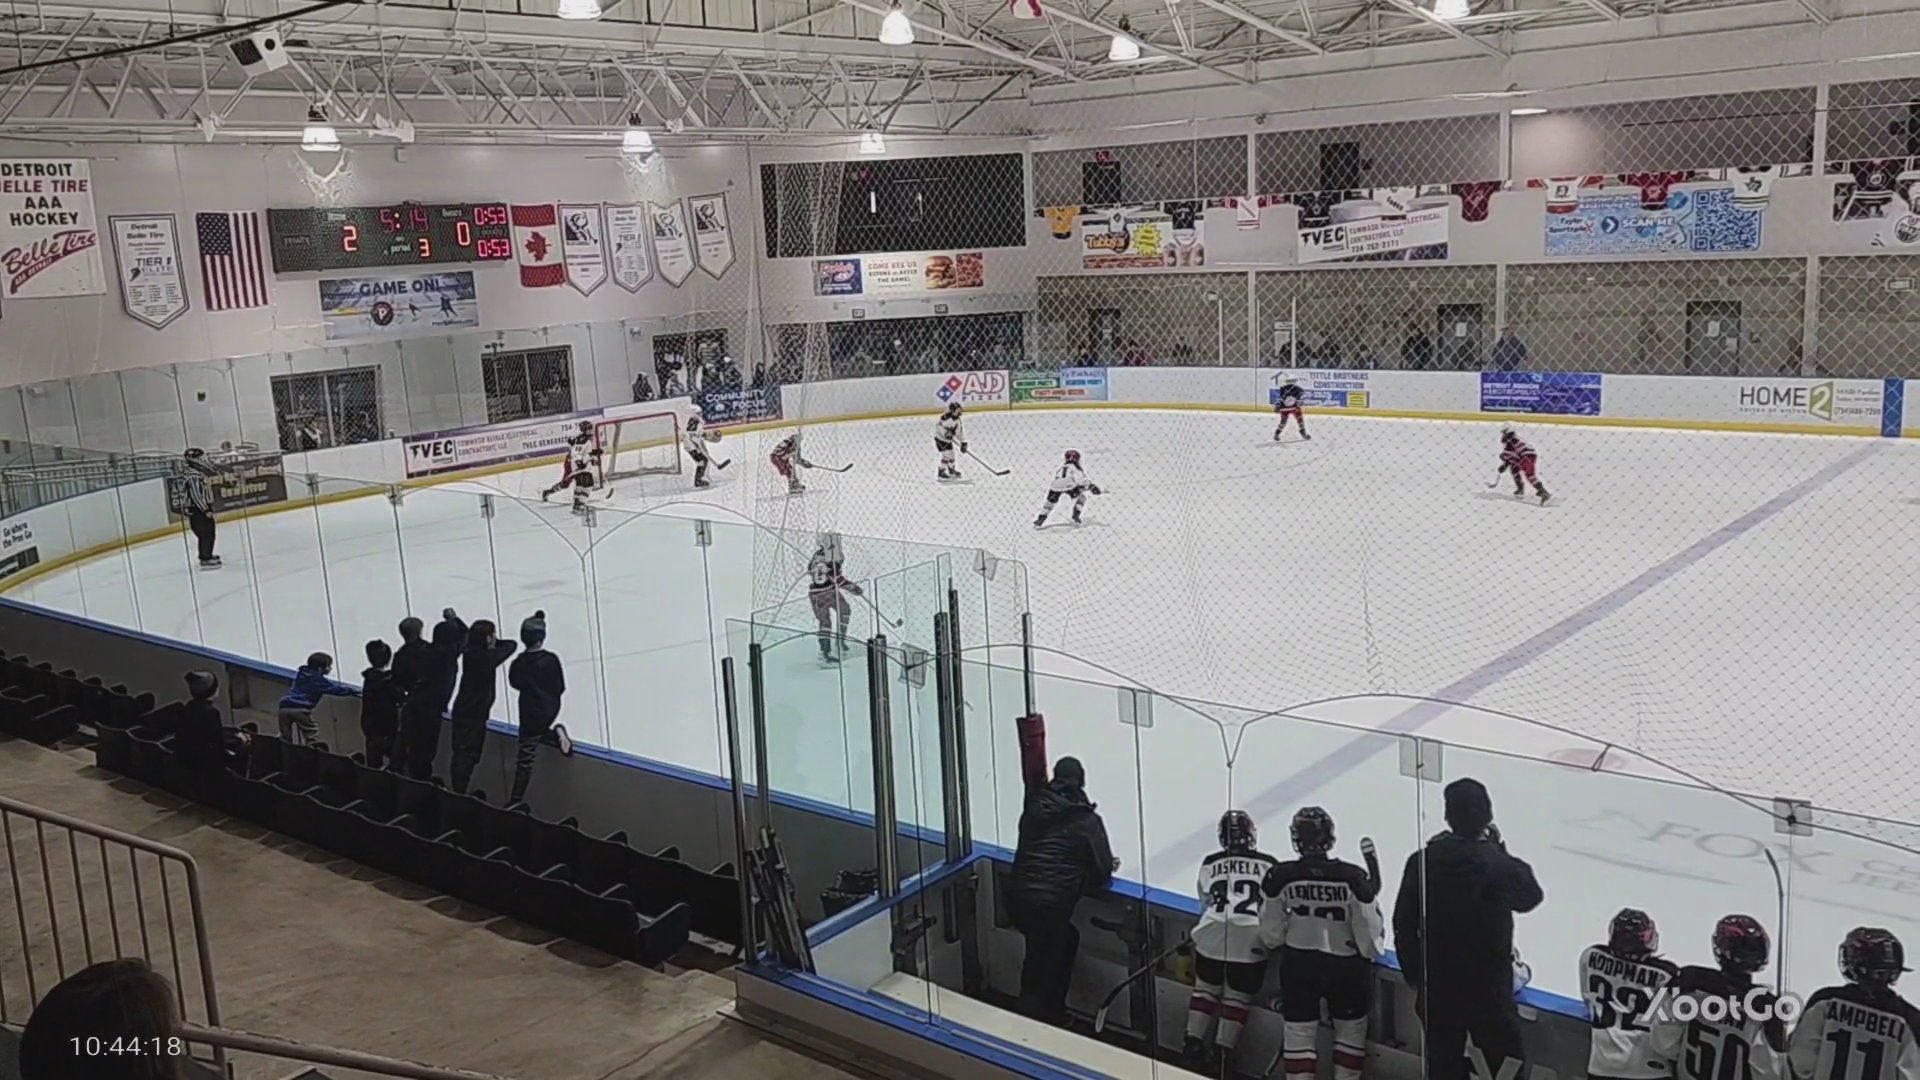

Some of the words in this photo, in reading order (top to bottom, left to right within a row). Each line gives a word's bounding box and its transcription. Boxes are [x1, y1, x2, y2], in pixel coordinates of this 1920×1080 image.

[1, 163, 72, 176] DETROIT
[0, 179, 43, 193] ELLE
[51, 179, 88, 192] TIRE
[25, 196, 62, 209] AAA
[9, 212, 79, 226] HOCKEY
[474, 207, 507, 225] 0:53
[1622, 217, 1655, 228] SCAN
[1658, 215, 1675, 226] ME
[343, 225, 358, 251] 2
[457, 221, 470, 246] 0
[1300, 225, 1345, 247] TVEC
[1, 238, 60, 275] Belle
[53, 229, 97, 257] Tire
[419, 238, 430, 257] 3
[477, 239, 510, 257] 0:53
[135, 256, 163, 267] TIER
[360, 280, 408, 297] GAME
[705, 389, 766, 402] COMMUNITY
[732, 399, 767, 410] FOCUS
[1739, 386, 1808, 407] HOME
[1812, 385, 1831, 418] 2
[409, 439, 453, 459] TVEC
[1640, 820, 1834, 876] FOX
[1210, 859, 1261, 879] JASKELA
[1588, 951, 1660, 988] KOOPMAN
[1826, 1028, 1885, 1080] 11
